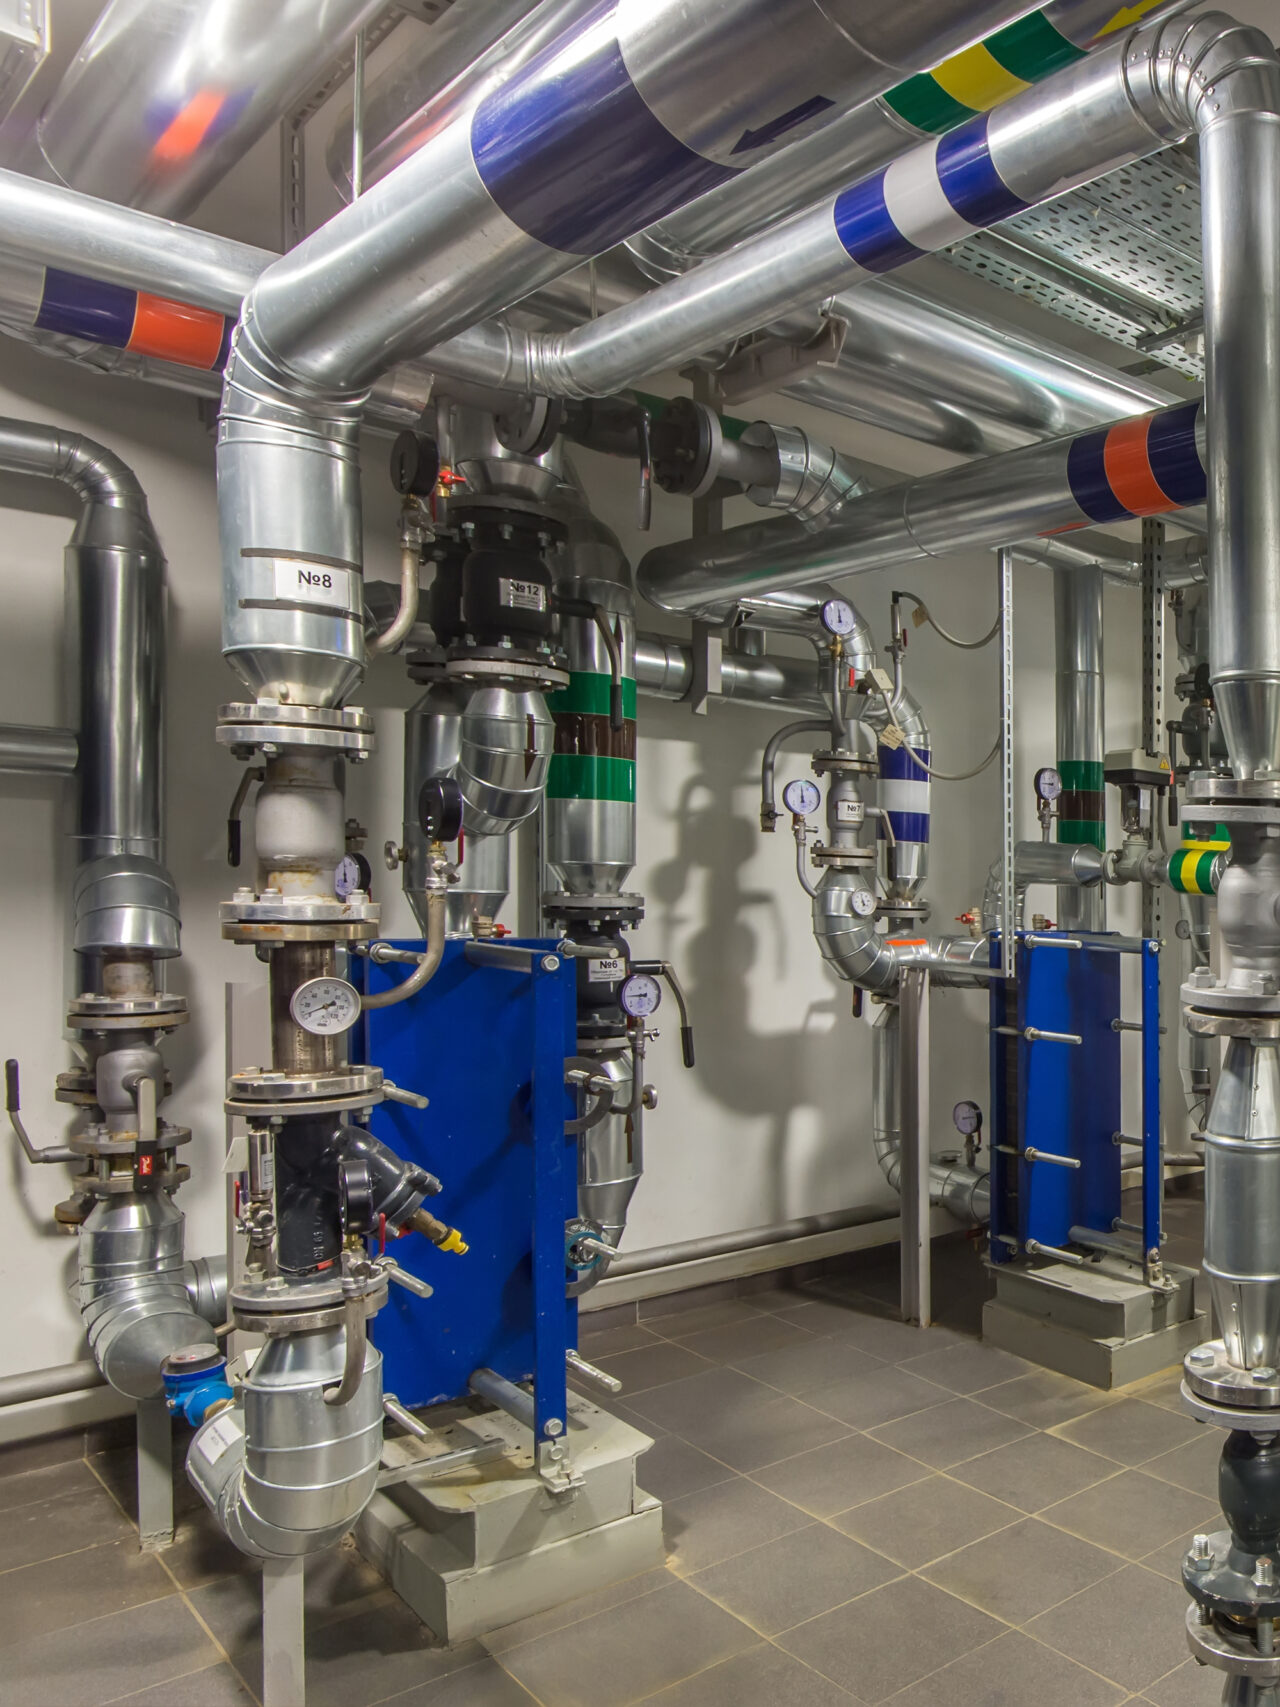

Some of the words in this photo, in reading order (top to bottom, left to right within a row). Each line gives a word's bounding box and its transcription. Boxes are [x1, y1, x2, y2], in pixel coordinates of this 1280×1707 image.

[298, 569, 332, 588] №8
[510, 581, 539, 596] №12
[600, 960, 618, 969] №6
